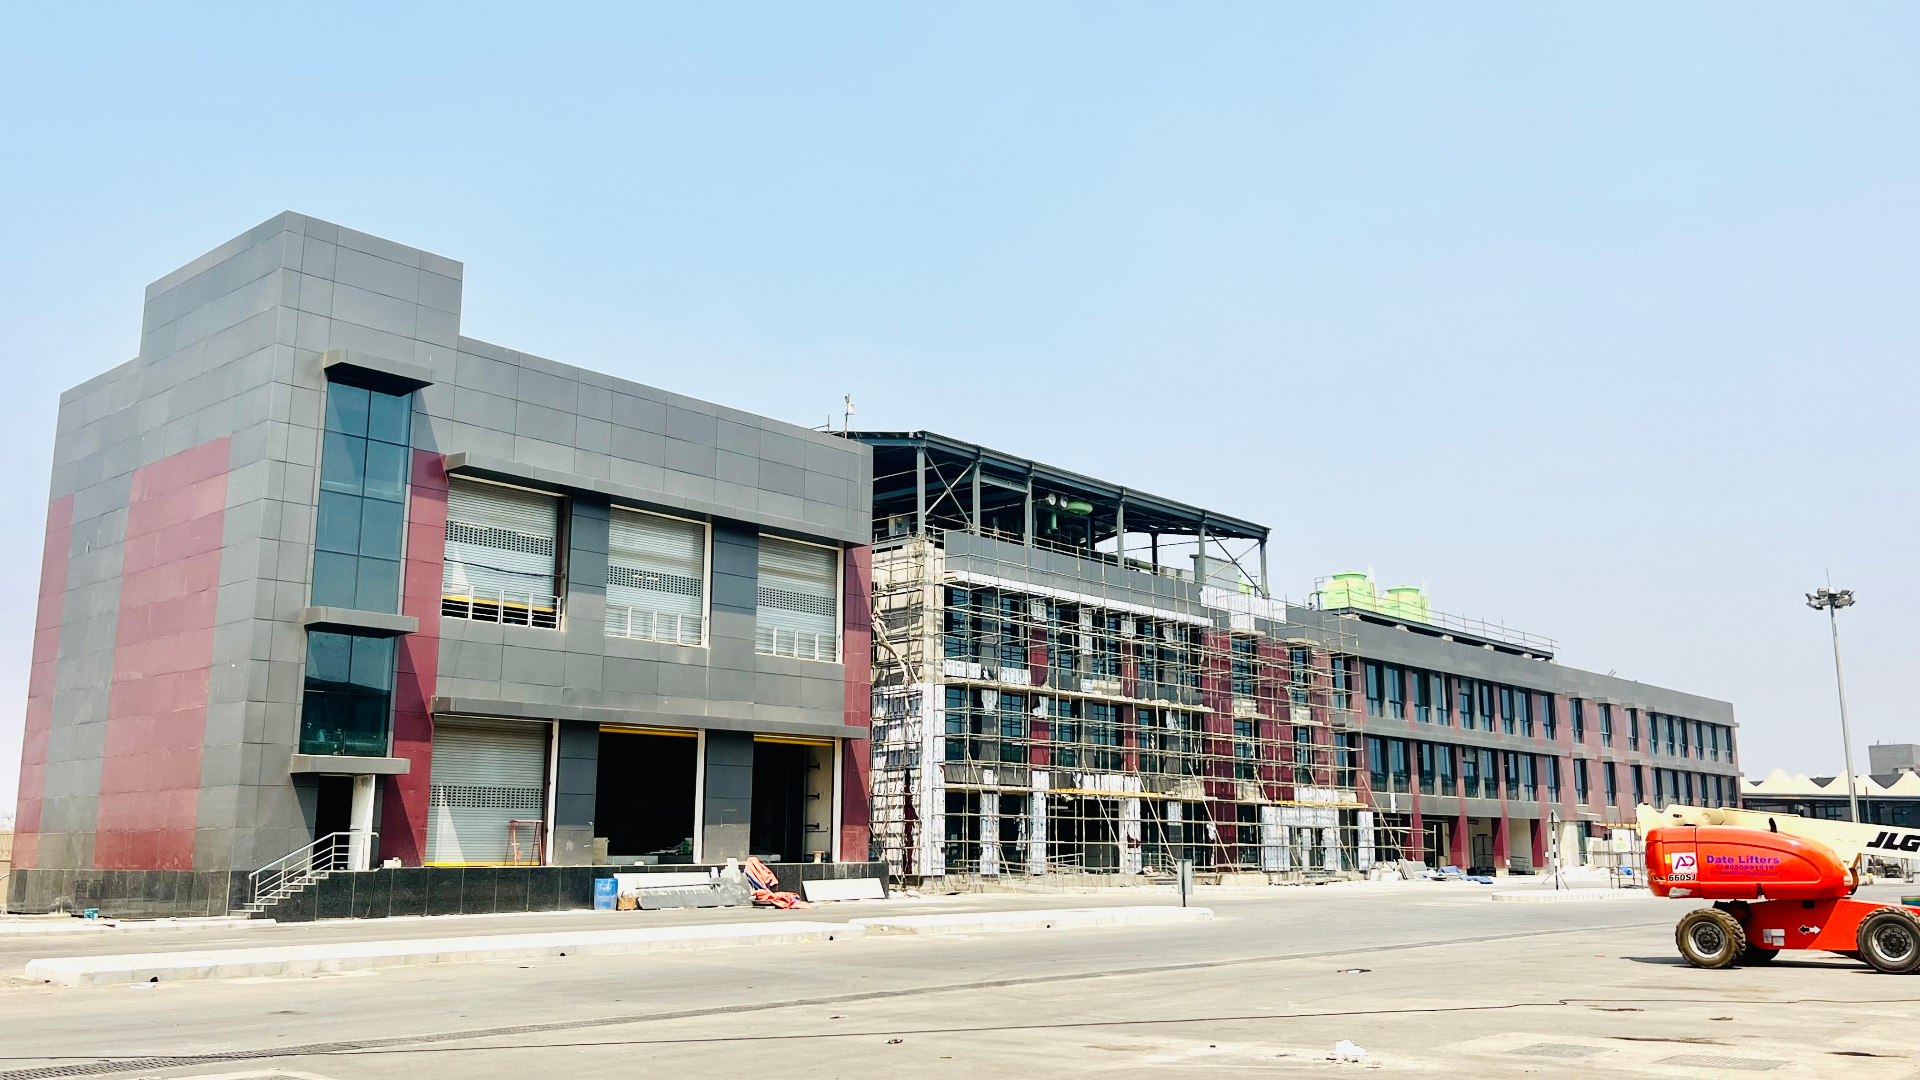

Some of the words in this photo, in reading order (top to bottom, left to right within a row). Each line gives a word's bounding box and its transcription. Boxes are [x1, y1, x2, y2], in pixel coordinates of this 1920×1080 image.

[1866, 831, 1920, 852] JLG
[1706, 854, 1735, 864] Date
[1738, 854, 1780, 864] Lifters
[1668, 873, 1696, 882] 660SJ
